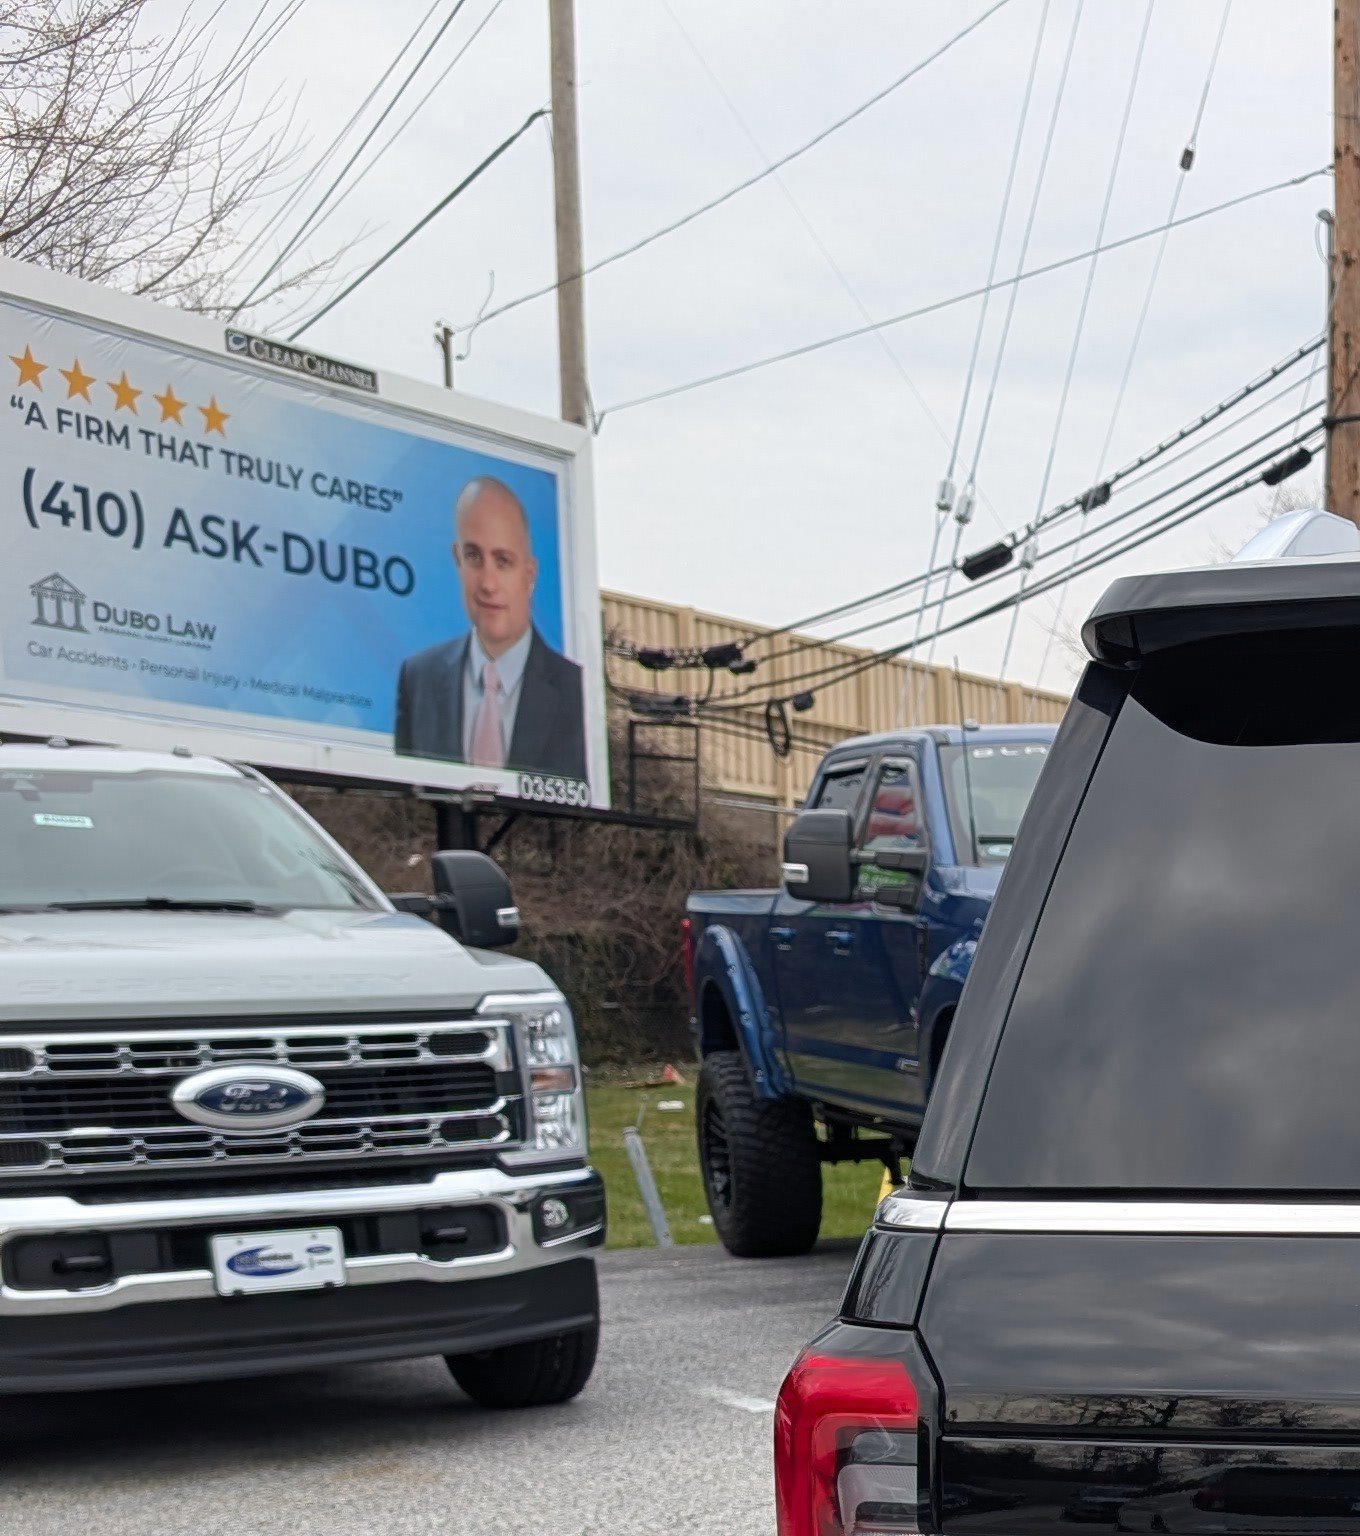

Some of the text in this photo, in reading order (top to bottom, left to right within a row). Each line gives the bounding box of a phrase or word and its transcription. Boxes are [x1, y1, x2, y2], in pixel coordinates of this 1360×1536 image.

[56, 407, 130, 449] FIRM
[138, 428, 213, 469] THAT
[219, 449, 304, 491] TRULY
[23, 467, 415, 597] (410) ASK-DUBO
[93, 601, 161, 632] DUBO
[166, 613, 217, 641] LAW
[27, 640, 53, 659] Car
[56, 645, 129, 671] Accidents
[520, 774, 590, 807] 035350
